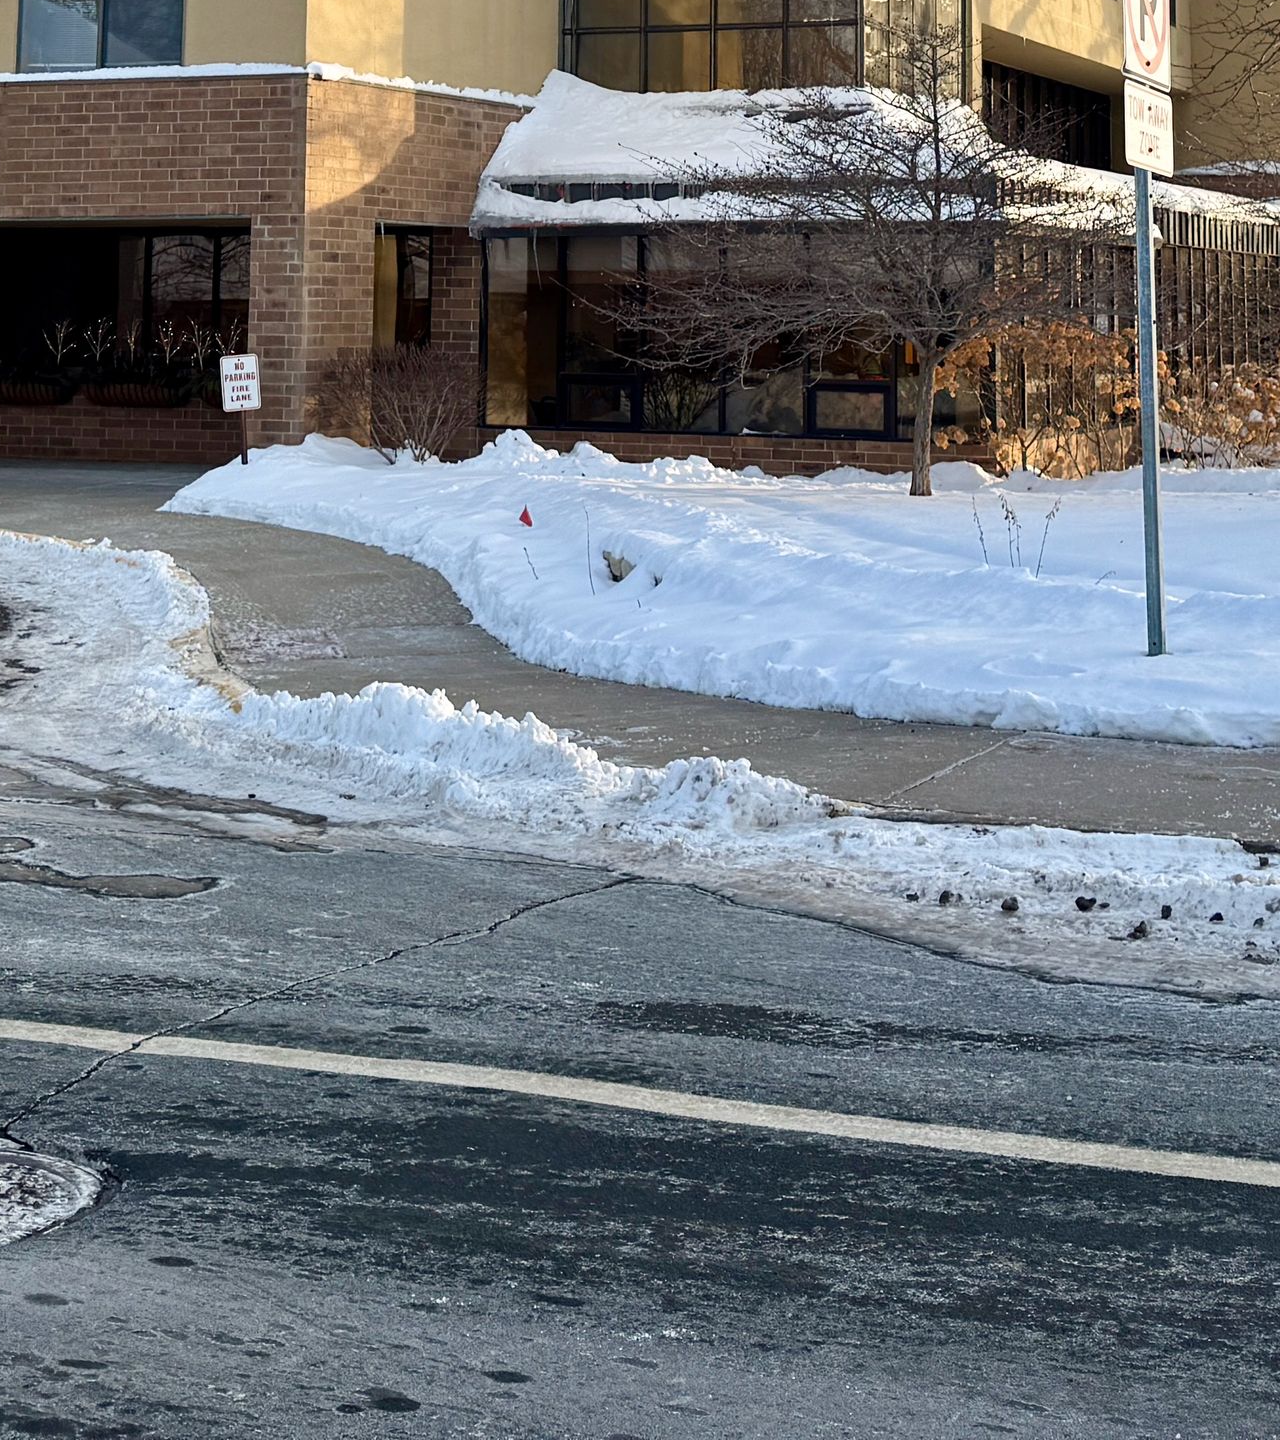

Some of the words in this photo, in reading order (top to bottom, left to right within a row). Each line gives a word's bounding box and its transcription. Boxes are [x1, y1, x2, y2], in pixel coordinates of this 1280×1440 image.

[1128, 94, 1145, 122] TOW
[1148, 103, 1169, 131] AWAY
[1139, 130, 1161, 159] ZONE
[234, 362, 244, 370] NO
[225, 372, 256, 382] PARKING
[231, 394, 252, 402] LANE
